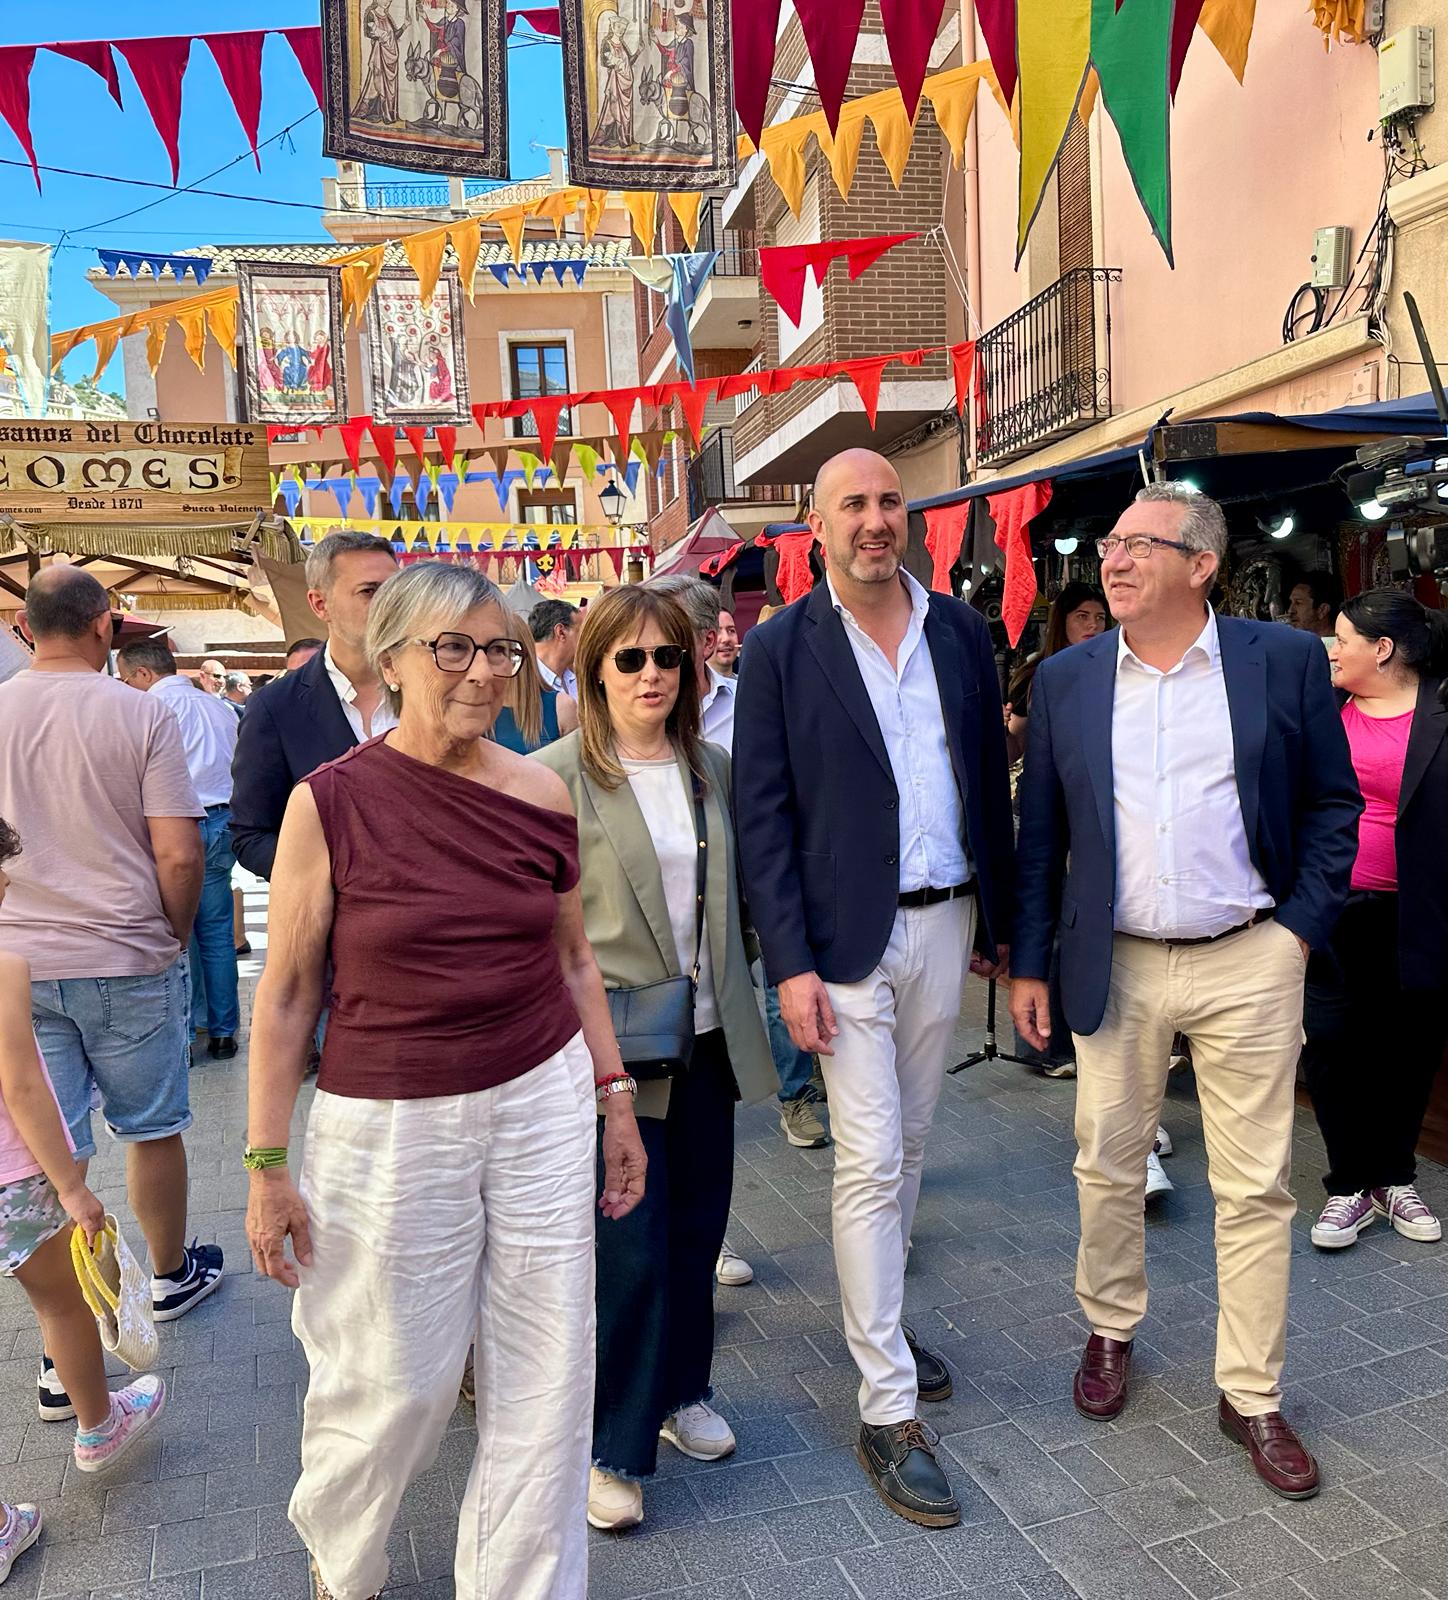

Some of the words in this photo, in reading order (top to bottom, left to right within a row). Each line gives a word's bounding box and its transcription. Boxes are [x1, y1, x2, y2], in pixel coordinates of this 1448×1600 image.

[0, 427, 72, 443] sanos
[86, 422, 121, 443] del
[134, 423, 254, 446] Chocolate
[67, 497, 105, 510] Desde
[111, 498, 143, 510] 1870
[182, 503, 215, 513] Sueca
[219, 503, 264, 513] Valencia
